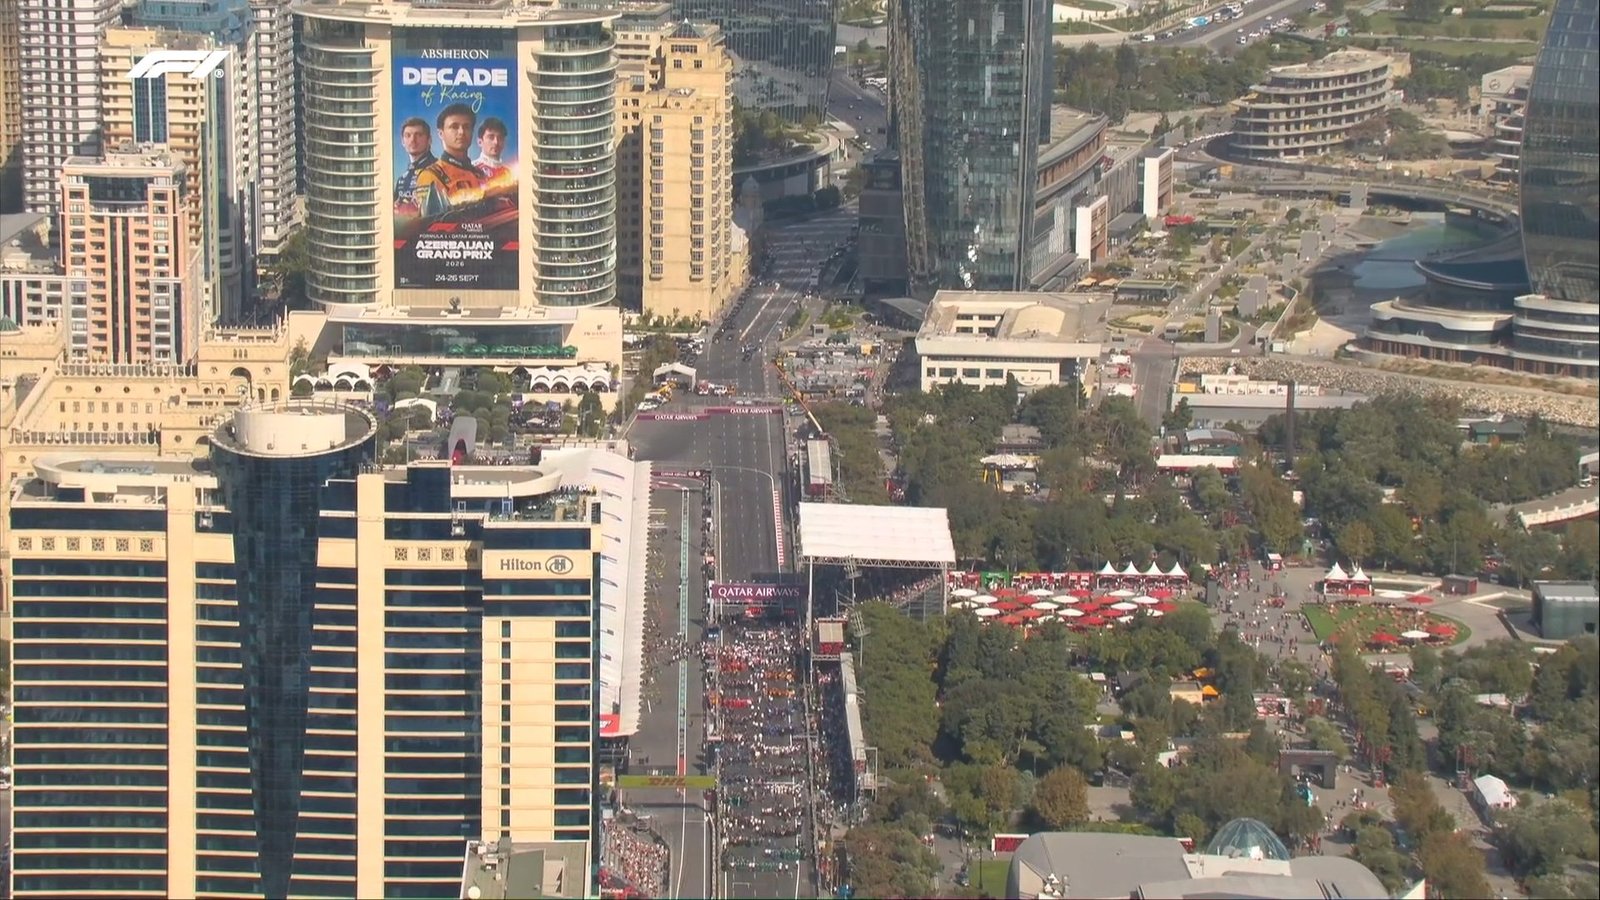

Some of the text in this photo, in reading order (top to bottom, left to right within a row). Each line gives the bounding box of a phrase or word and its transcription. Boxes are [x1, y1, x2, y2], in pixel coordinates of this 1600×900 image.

[421, 49, 489, 59] ABSHERON
[402, 67, 508, 86] DECADE
[421, 83, 485, 113] of Racing
[415, 240, 494, 250] AZERBAIJAN
[416, 250, 493, 260] GRAND PRIX
[500, 558, 542, 571] Hilton
[718, 587, 800, 598] QATAR AIRWAYS
